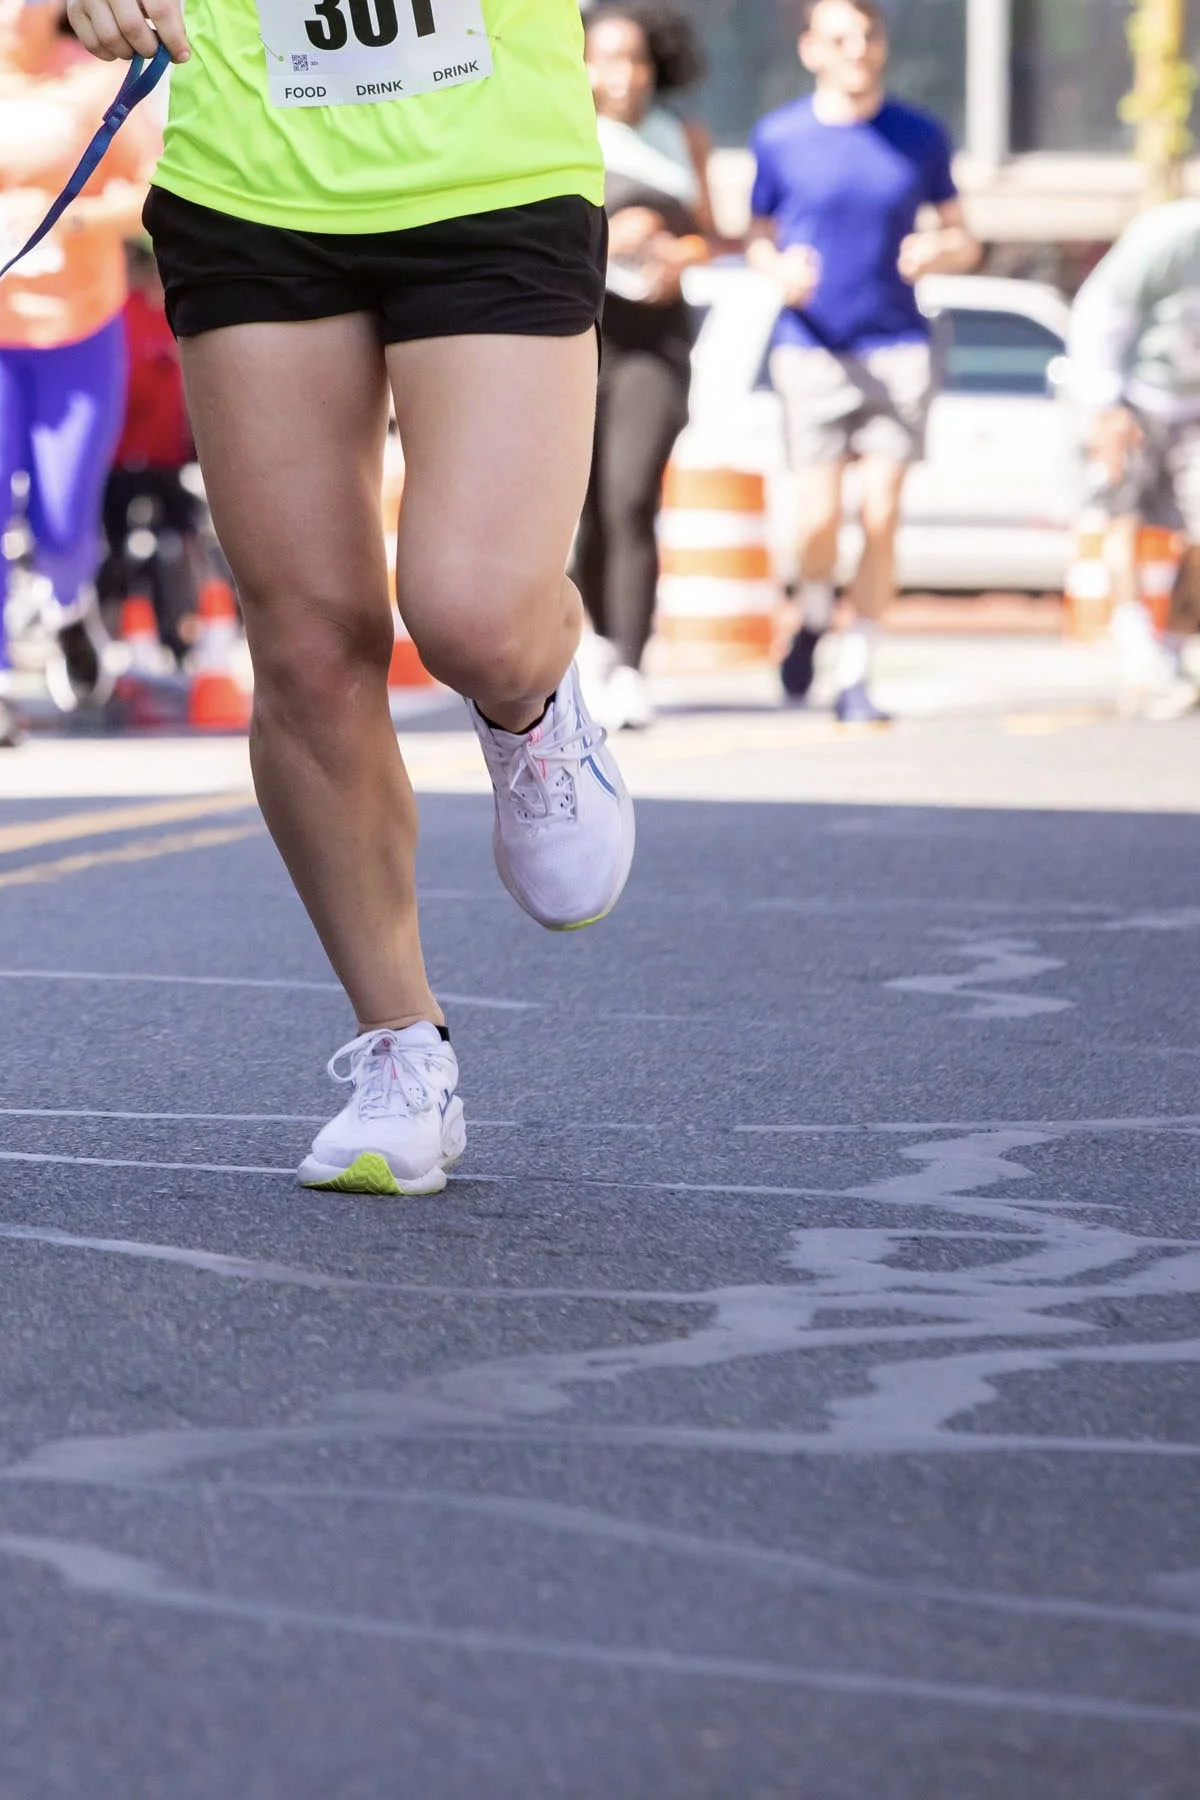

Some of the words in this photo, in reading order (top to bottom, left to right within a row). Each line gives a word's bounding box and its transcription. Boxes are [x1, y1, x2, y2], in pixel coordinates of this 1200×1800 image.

[285, 86, 327, 99] FOOD
[356, 80, 404, 96] DRINK
[433, 60, 479, 82] DRINK
